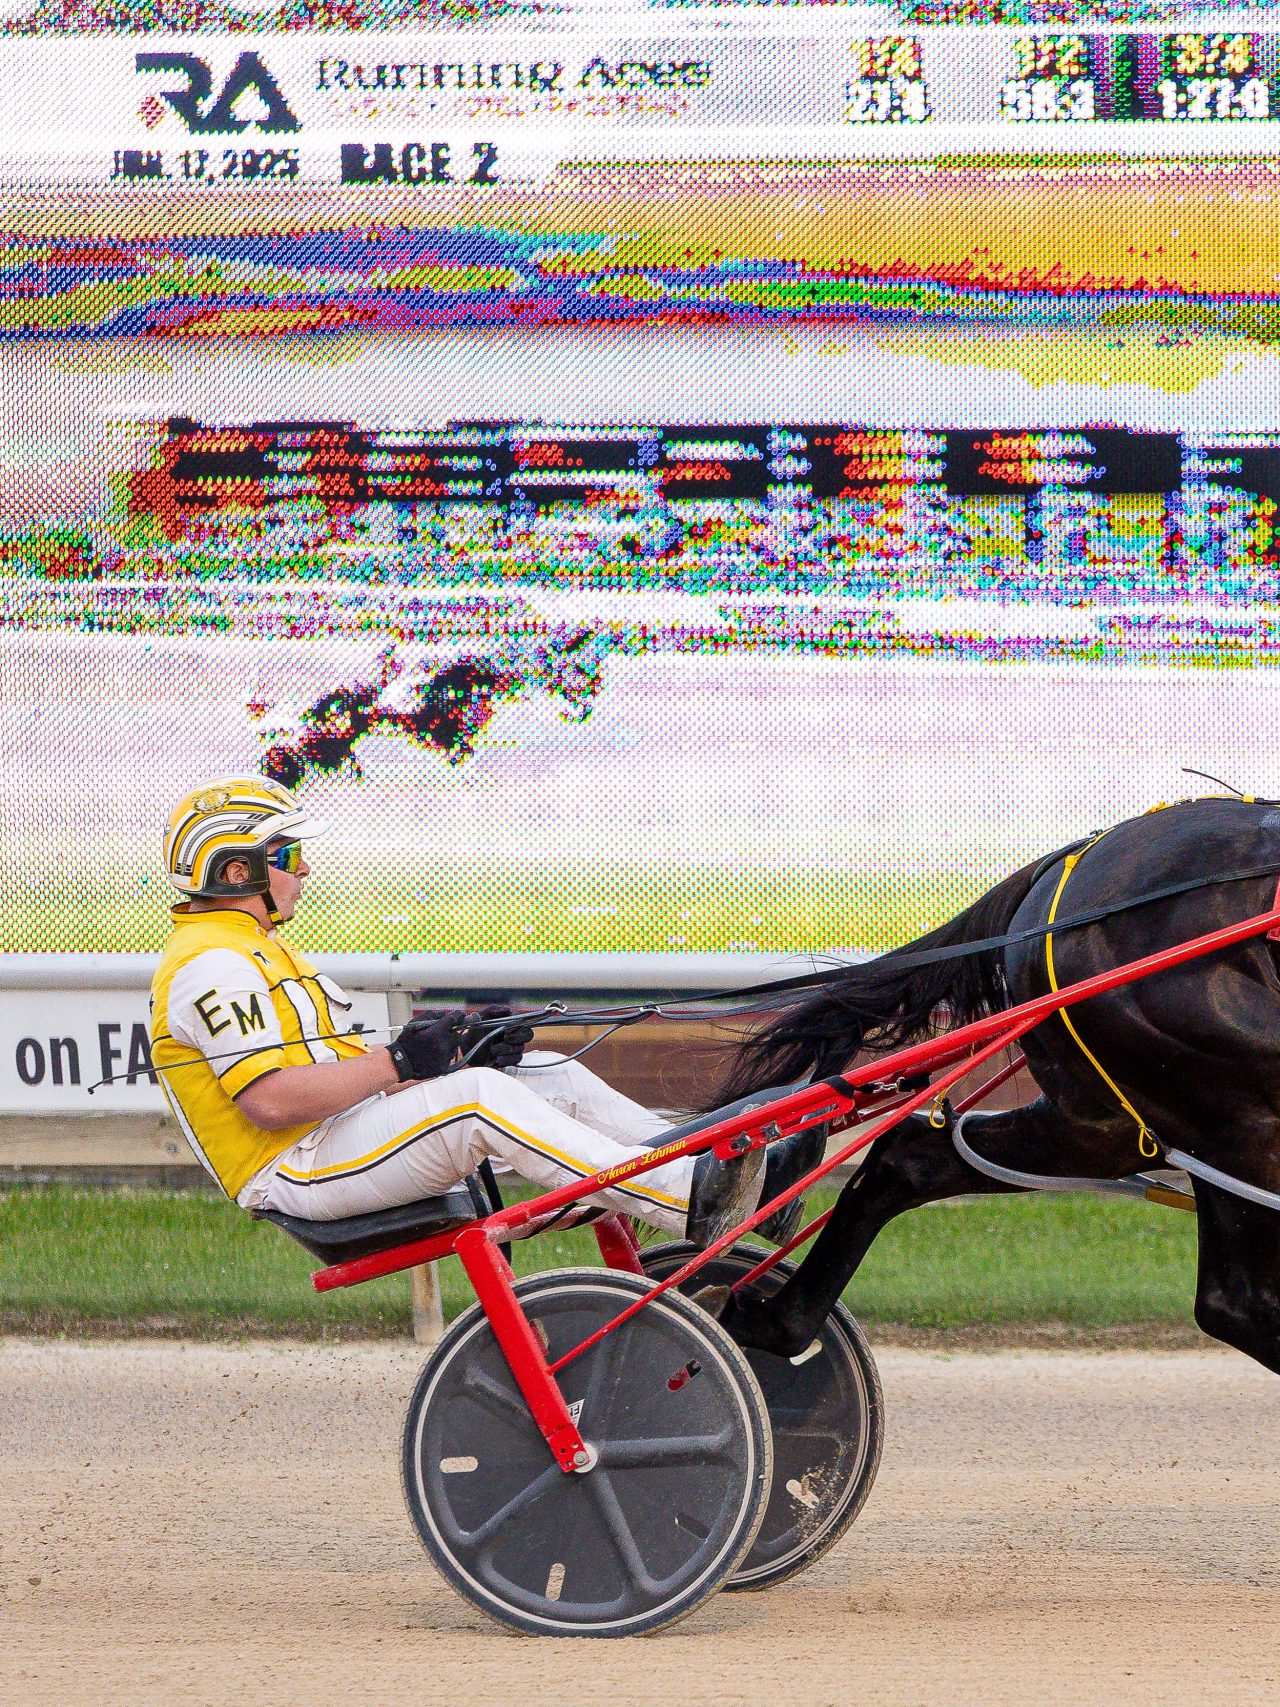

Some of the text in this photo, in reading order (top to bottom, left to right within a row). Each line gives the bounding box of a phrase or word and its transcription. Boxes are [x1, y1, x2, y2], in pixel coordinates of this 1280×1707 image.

[315, 57, 712, 93] Running Aces
[341, 142, 500, 184] RACE 2
[16, 1038, 80, 1085] on
[597, 1140, 688, 1184] Aaron Lehman
